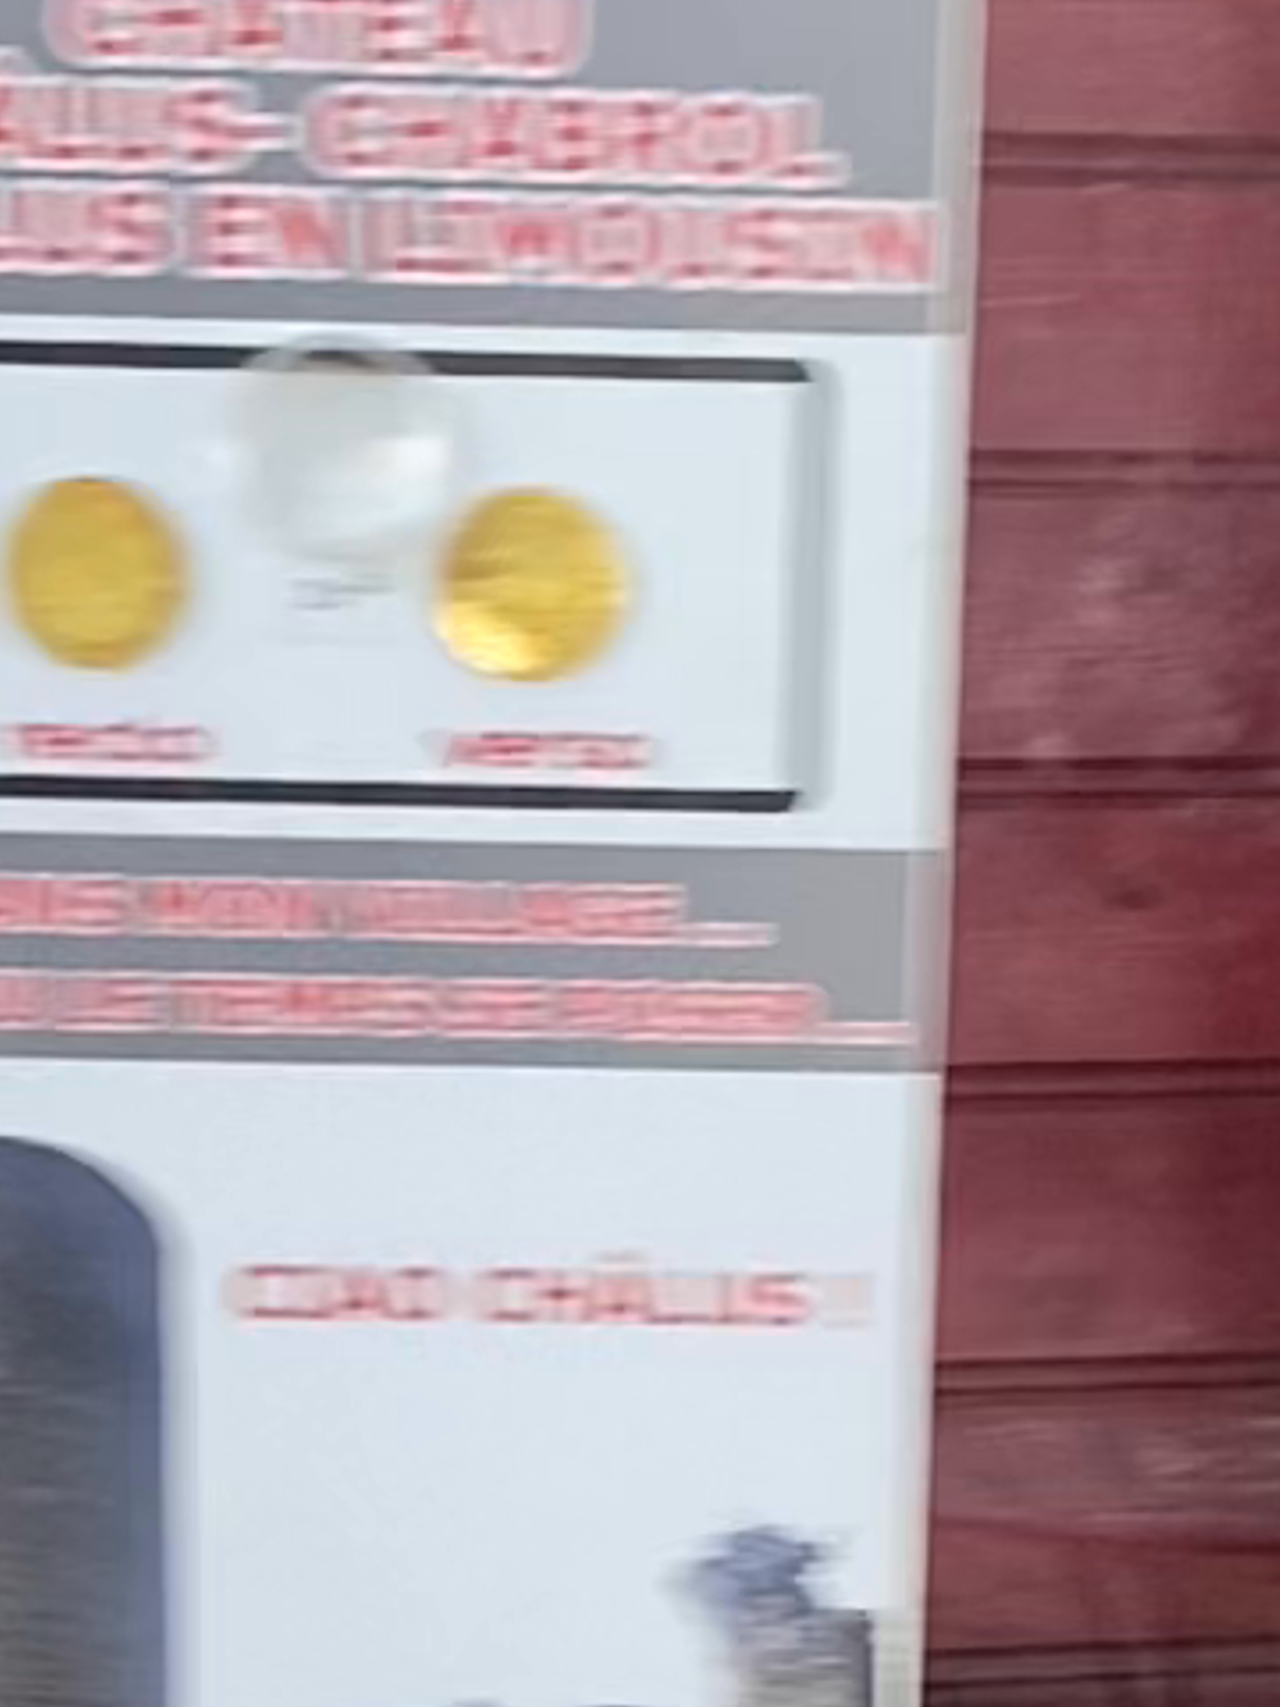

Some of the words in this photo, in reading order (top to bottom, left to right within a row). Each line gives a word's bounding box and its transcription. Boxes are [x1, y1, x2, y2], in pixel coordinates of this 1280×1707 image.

[312, 89, 842, 185] CHABROL
[184, 183, 346, 276] EN
[362, 190, 934, 288] LIMOUSIN
